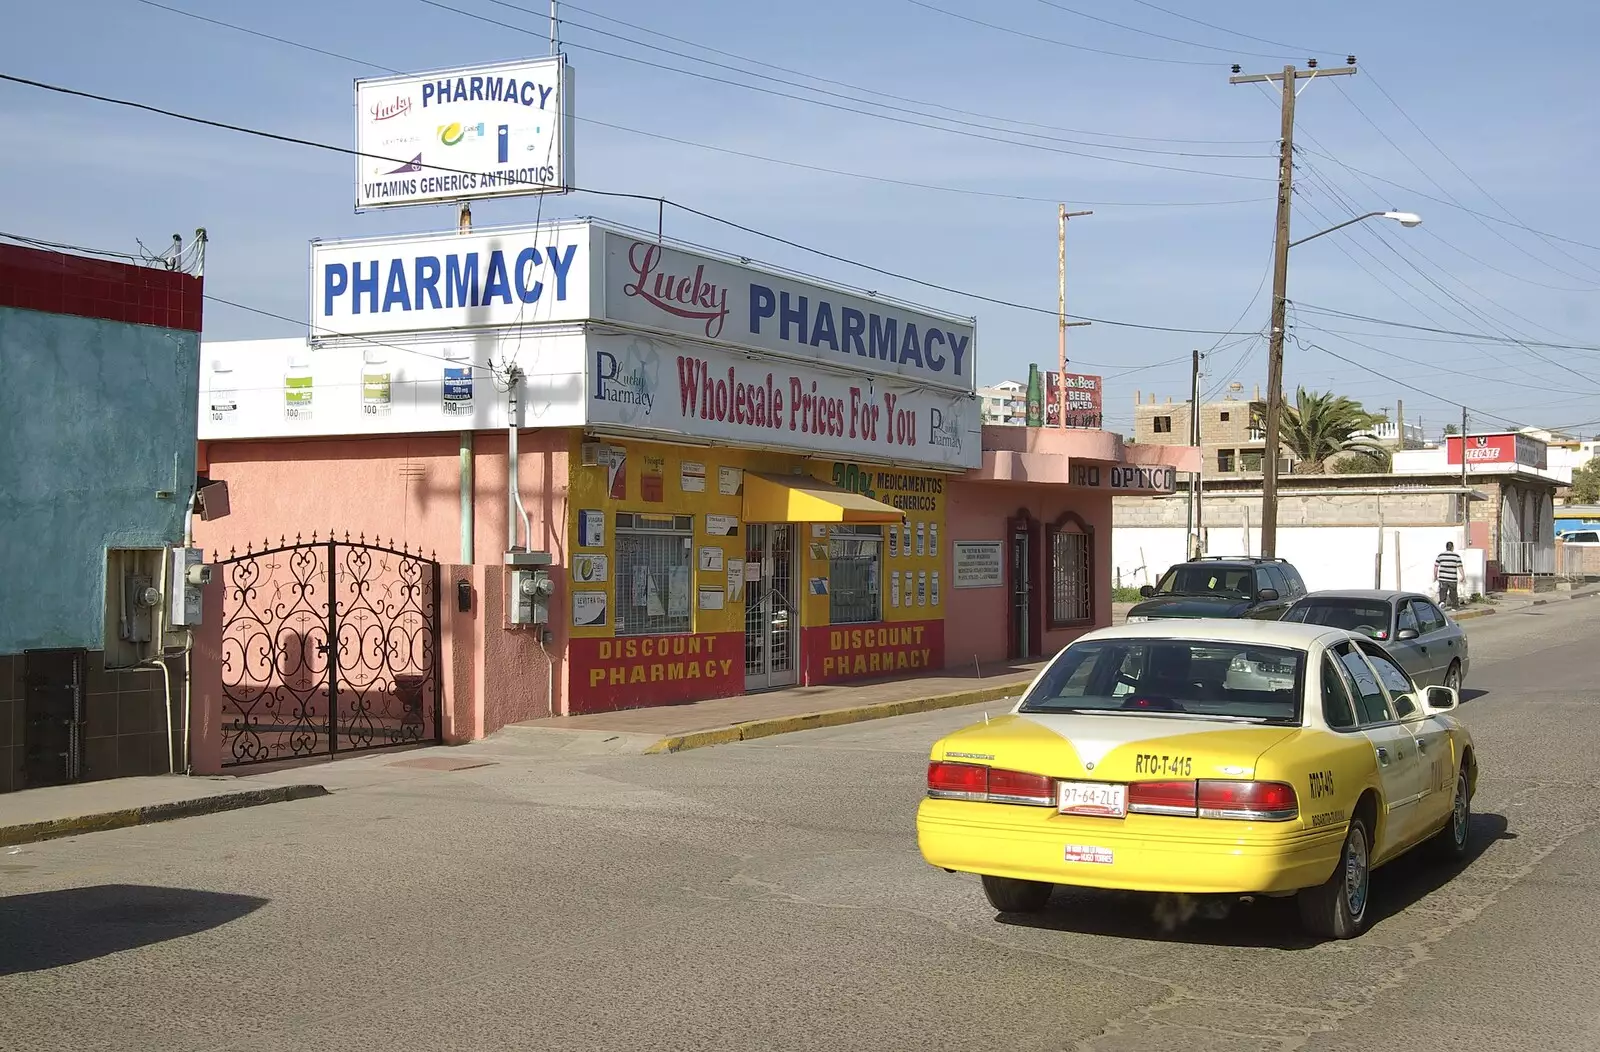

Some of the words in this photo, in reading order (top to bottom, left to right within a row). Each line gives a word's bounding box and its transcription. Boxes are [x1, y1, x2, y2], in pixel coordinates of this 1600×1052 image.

[370, 96, 413, 123] Lucky
[422, 77, 553, 110] PHARMACY
[365, 179, 417, 198] VITAMINS
[420, 173, 477, 193] GENERICS
[480, 165, 554, 188] ANTIBIOTICS
[324, 244, 578, 316] PHARMACY
[624, 242, 729, 338] Lucky
[750, 283, 969, 376] PHARMACY
[594, 351, 655, 415] Pharmacy
[445, 402, 457, 411] 100
[677, 356, 782, 429] Wholesale
[789, 376, 843, 437] Prices
[849, 387, 879, 441] For
[884, 392, 916, 447] You
[1069, 391, 1091, 401] BEER
[286, 409, 298, 417] 100
[364, 405, 376, 414] 100
[1467, 448, 1500, 458] TECATE
[877, 472, 942, 494] MEDICAMENTOS
[1111, 467, 1171, 489] OPTICO
[893, 495, 936, 511] GENERICOS
[599, 636, 716, 659] DISCOUNT
[831, 626, 924, 651] DISCOUNT
[590, 659, 732, 687] PHARMACY
[823, 648, 930, 676] PHARMACY
